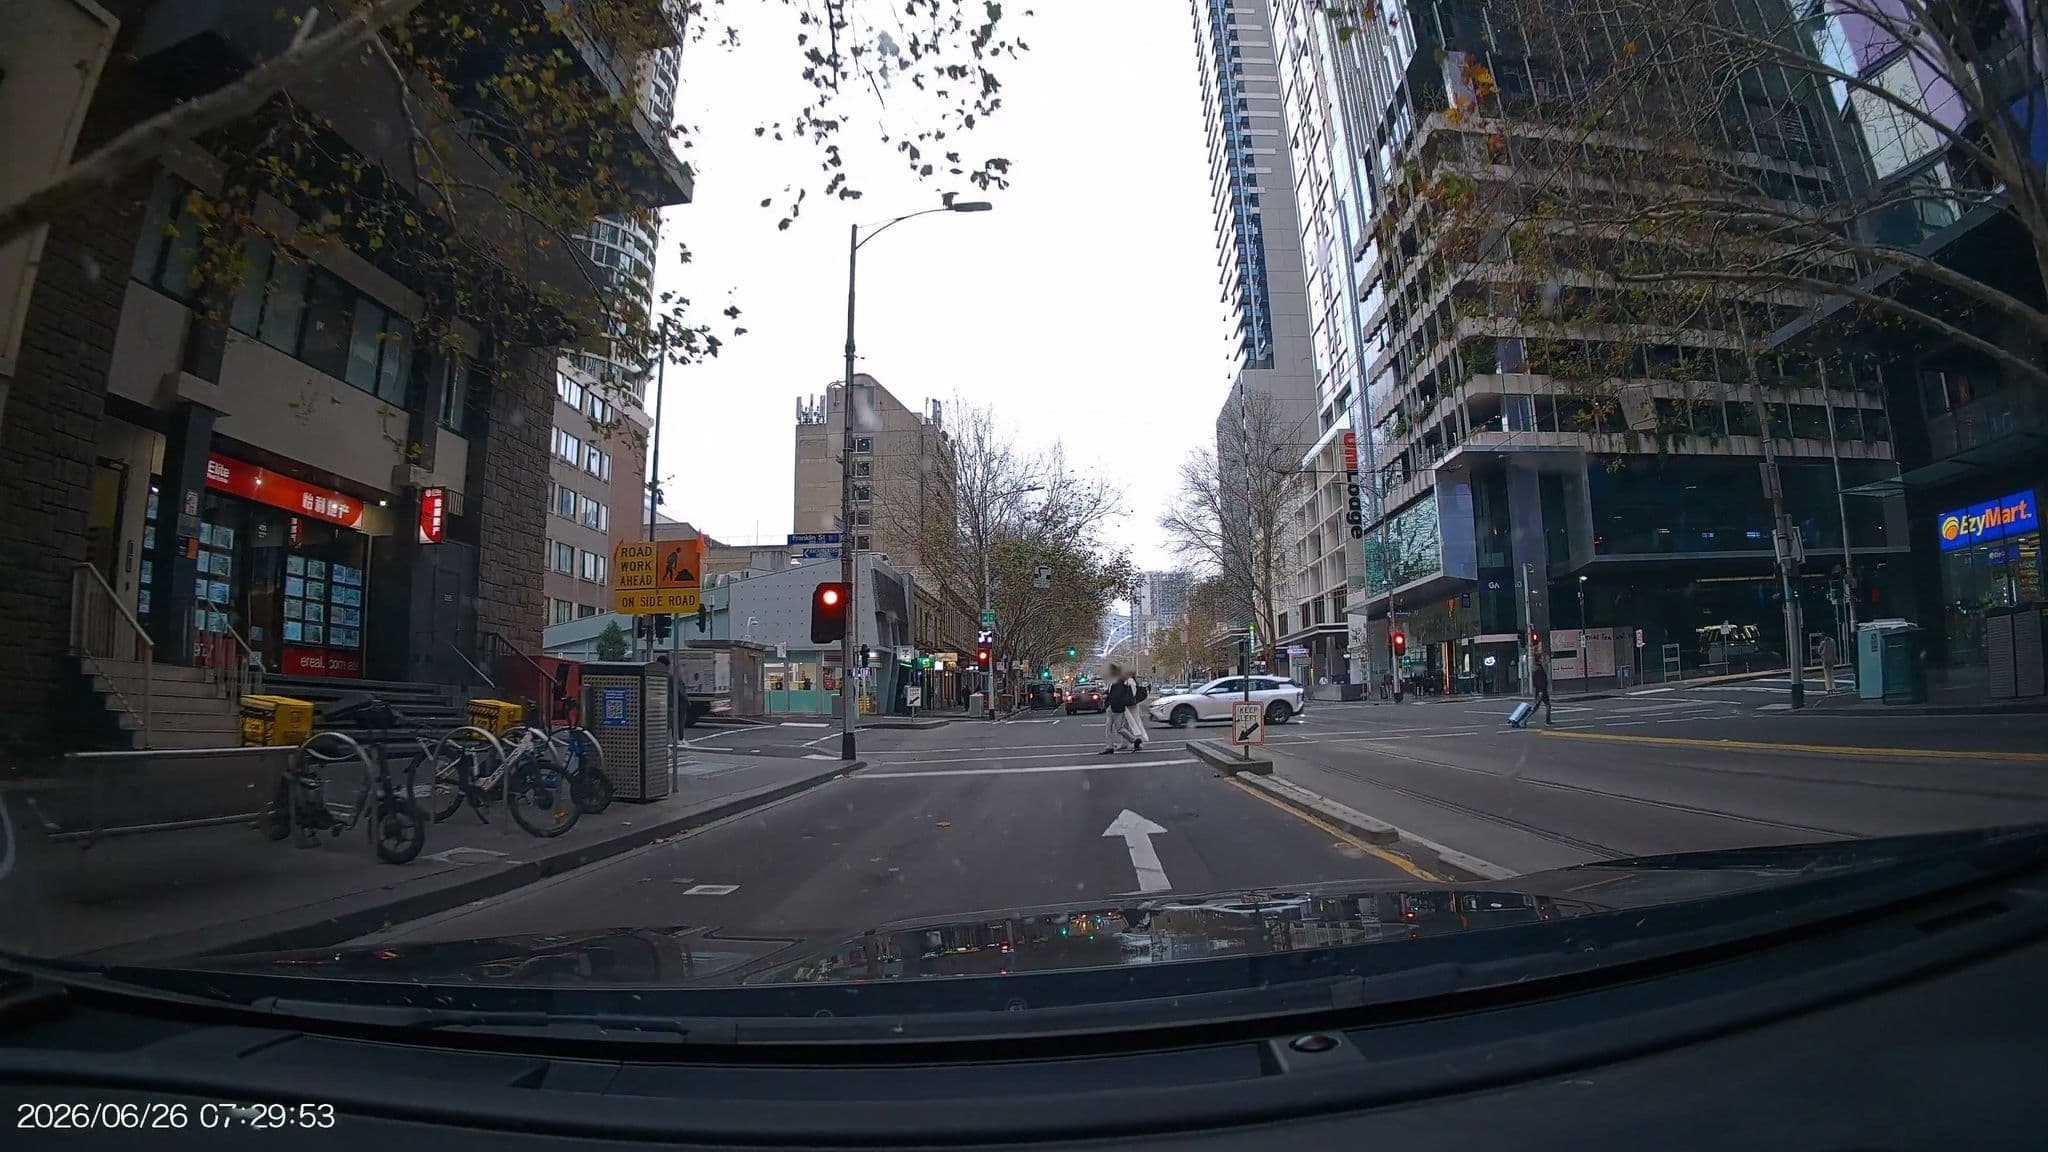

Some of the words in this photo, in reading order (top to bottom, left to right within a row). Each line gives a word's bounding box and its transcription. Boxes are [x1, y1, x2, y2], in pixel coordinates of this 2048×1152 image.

[208, 460, 230, 477] Elite
[1343, 432, 1363, 539] UniLodge
[620, 546, 652, 558] ROAD
[621, 560, 652, 572] WORK
[620, 574, 652, 586] AHEAD
[622, 597, 635, 608] ON
[640, 595, 664, 608] SIDE
[668, 594, 696, 606] ROAD
[1239, 706, 1258, 714] KEEP
[1240, 714, 1258, 722] LEFT
